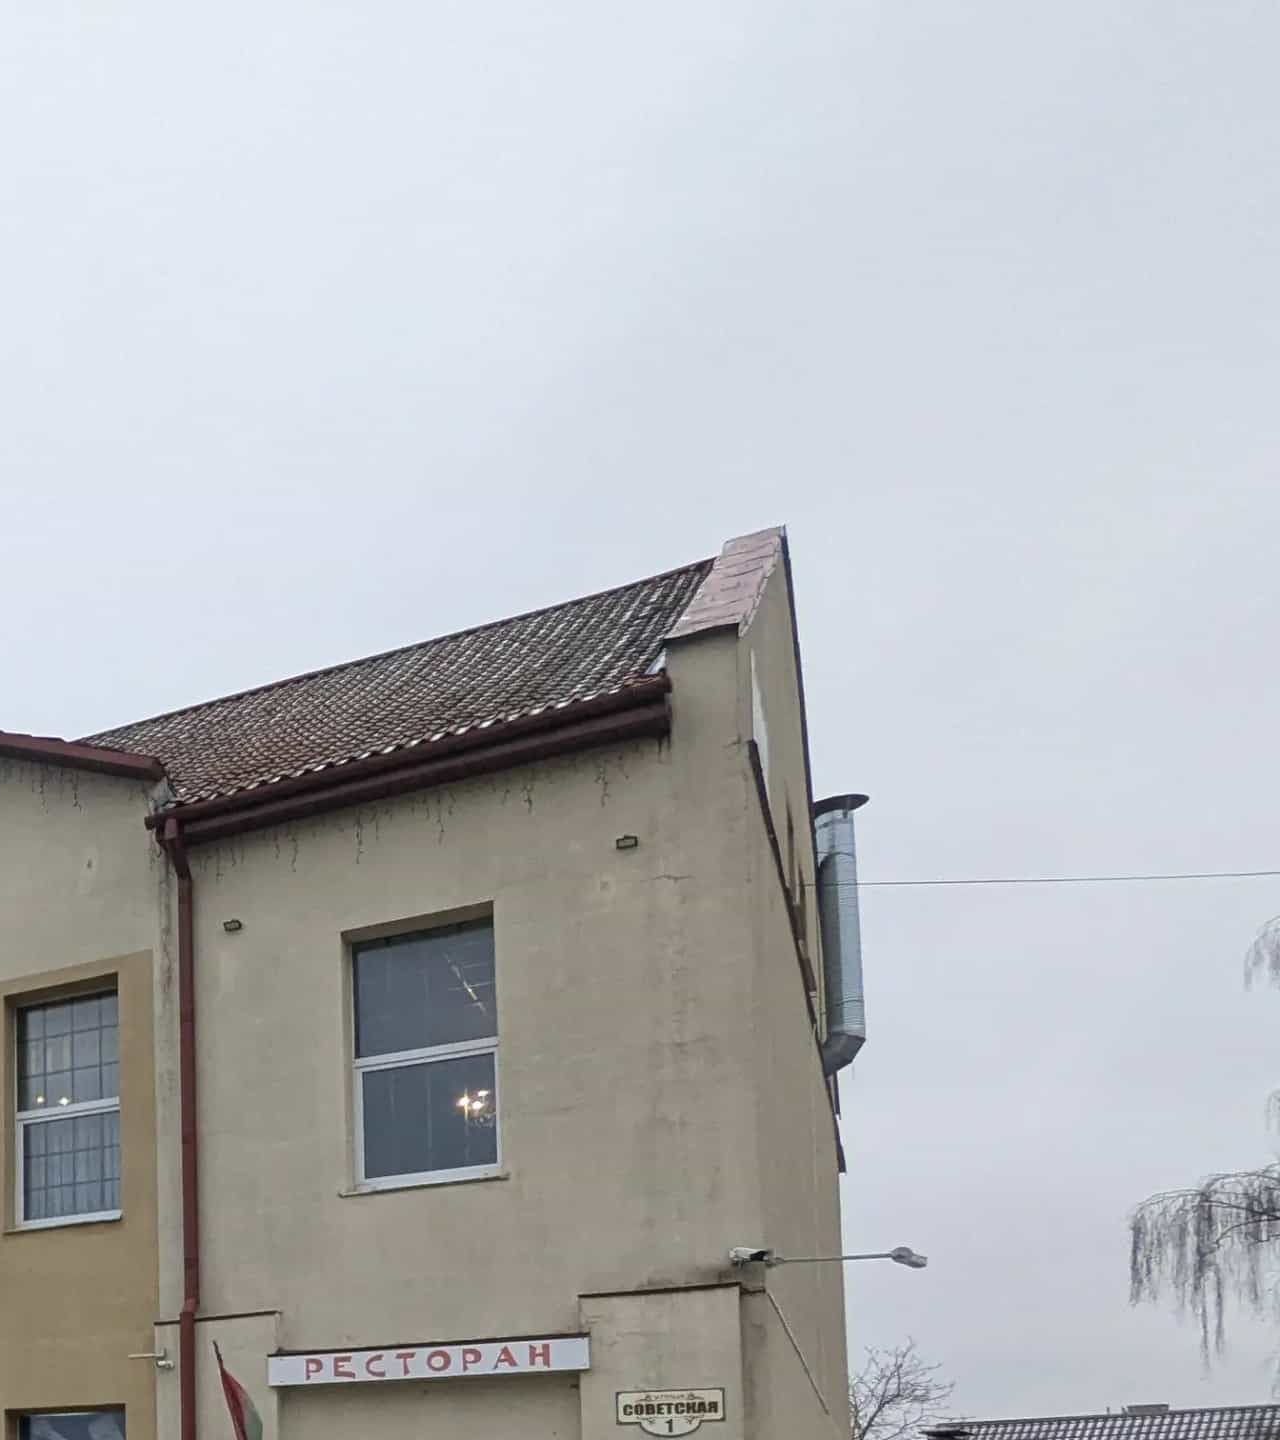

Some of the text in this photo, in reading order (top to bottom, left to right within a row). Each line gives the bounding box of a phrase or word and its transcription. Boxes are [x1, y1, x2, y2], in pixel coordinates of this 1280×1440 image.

[305, 1343, 551, 1381] РЕСТОРАН
[623, 1401, 719, 1416] СОВЕТСКАЯ
[665, 1418, 673, 1433] 1
